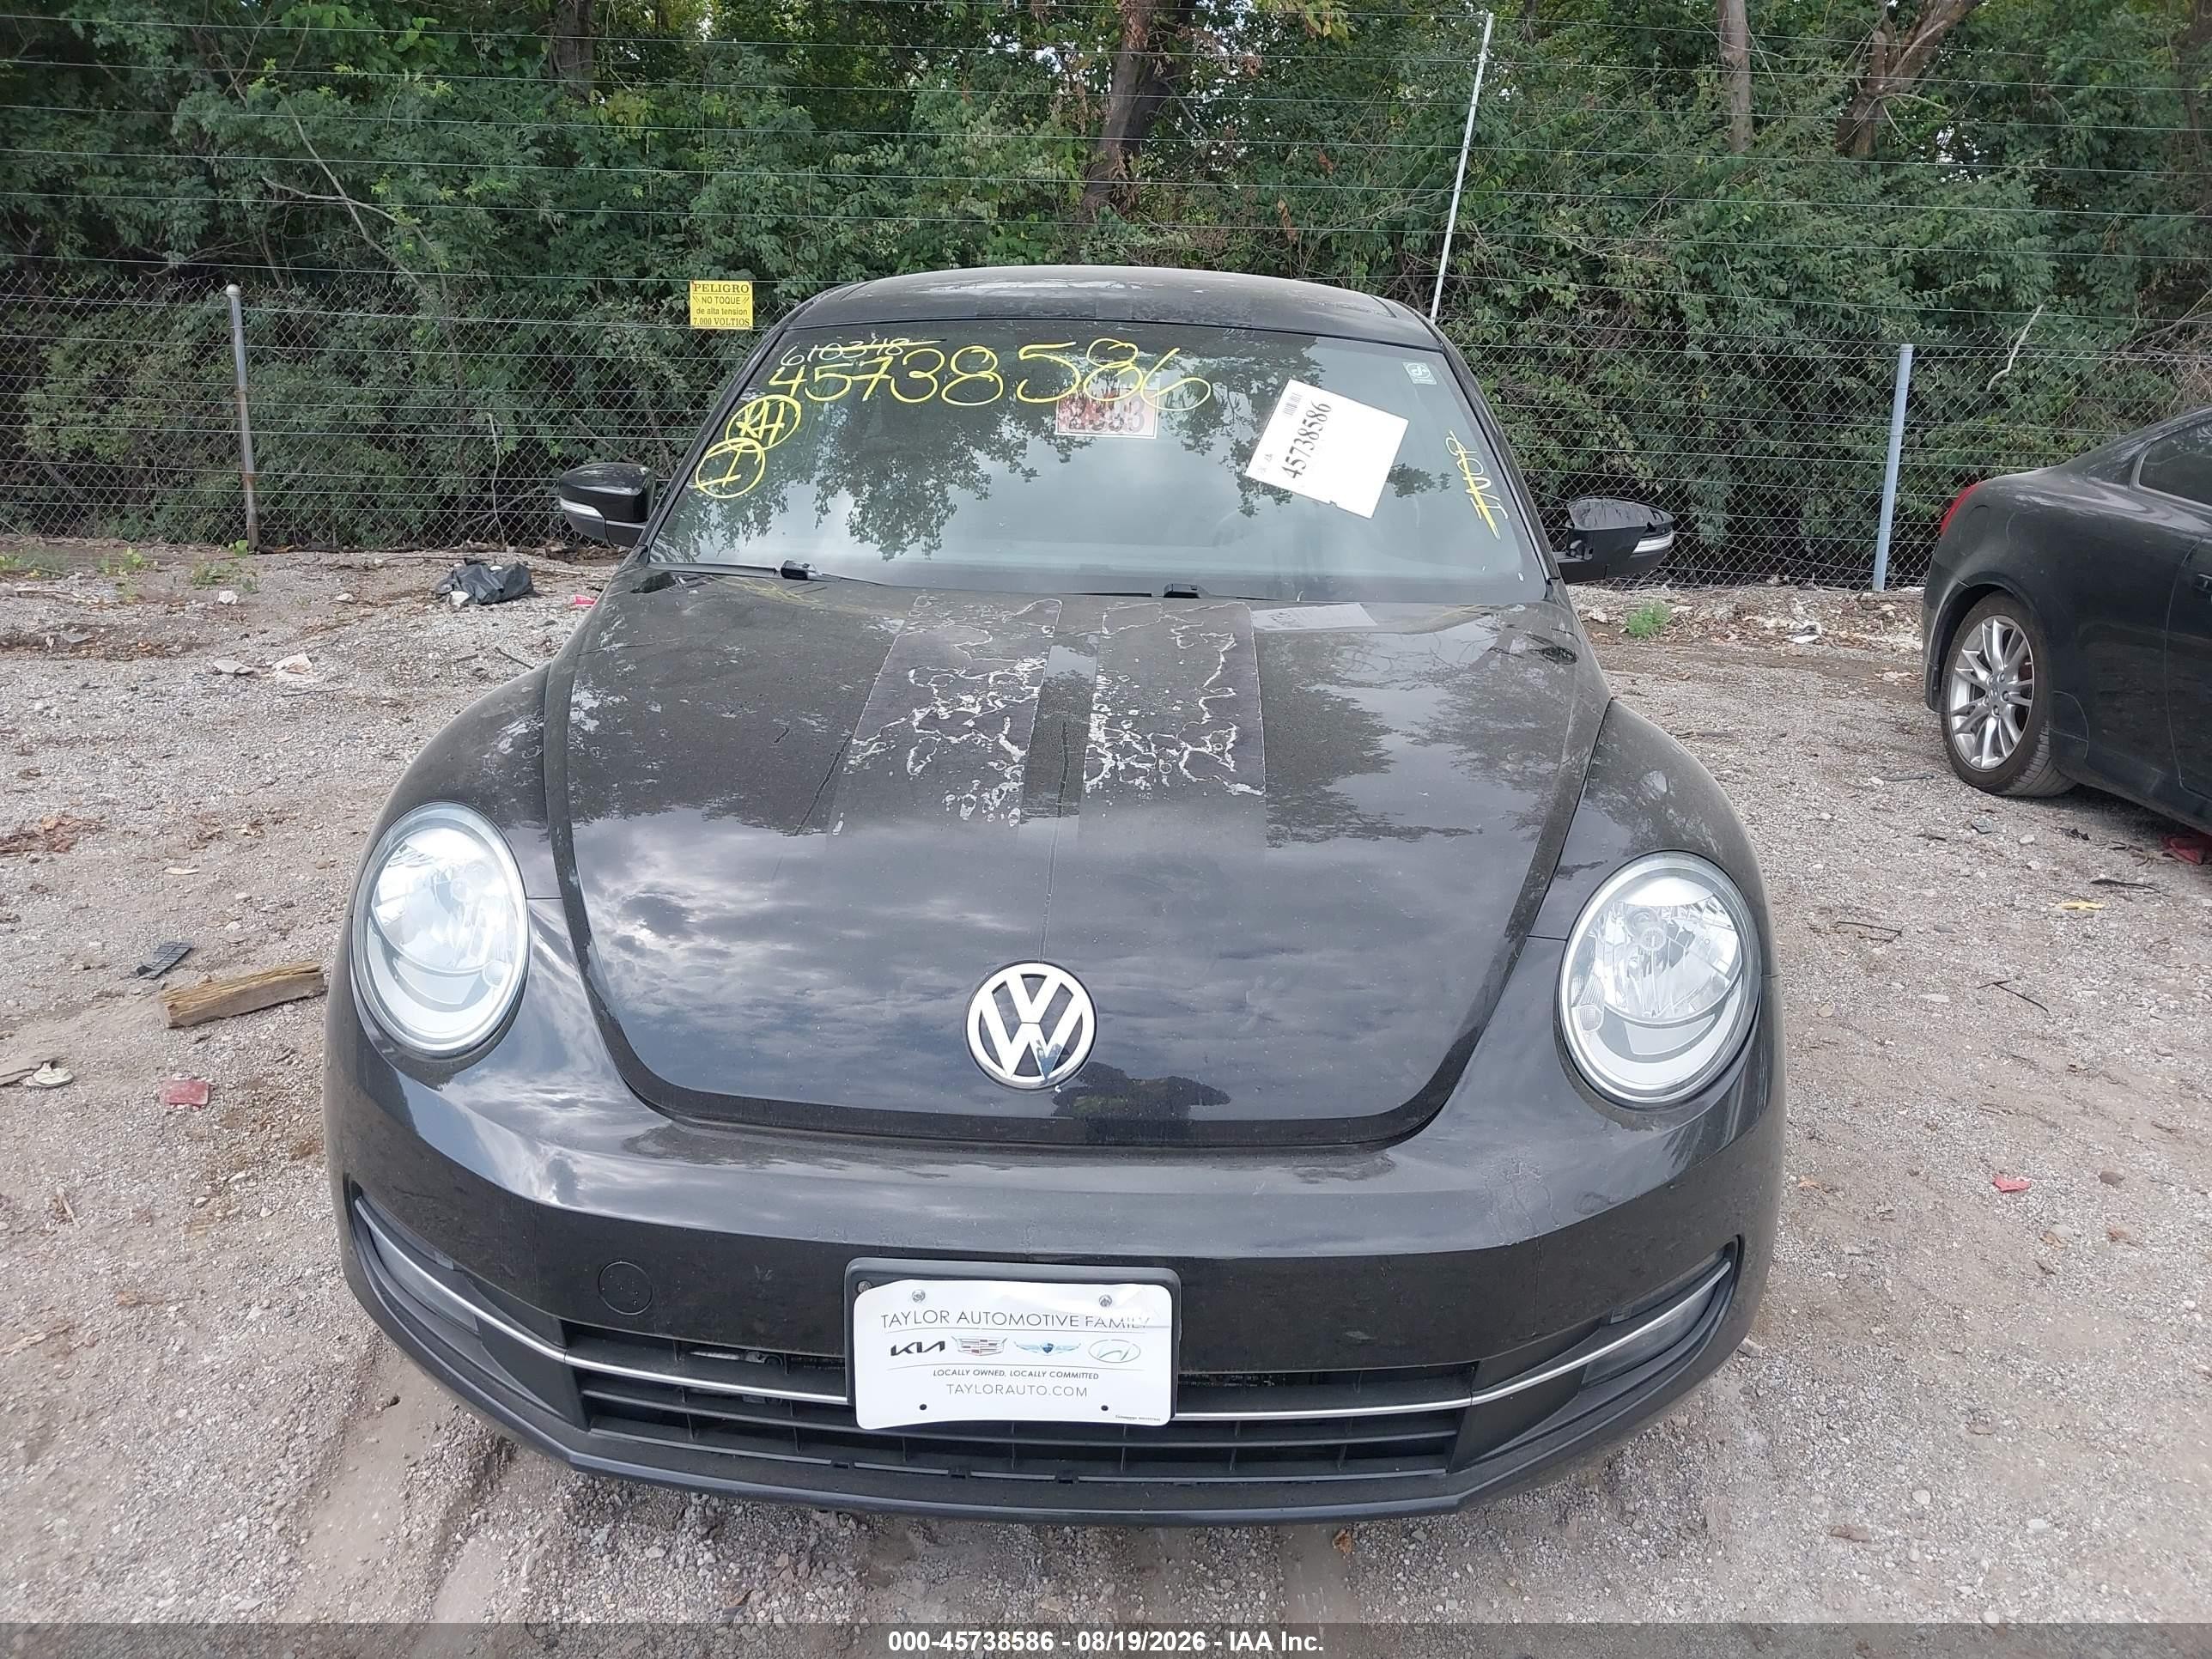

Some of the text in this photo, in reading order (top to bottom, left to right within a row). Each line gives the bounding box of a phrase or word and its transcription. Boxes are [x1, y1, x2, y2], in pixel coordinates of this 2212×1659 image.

[693, 283, 750, 293] PELIGRO
[714, 296, 741, 305] TOQUE
[714, 318, 750, 326] VOLTIOS
[768, 337, 1212, 411] 45738586
[1281, 399, 1333, 479] 45738586
[970, 966, 1091, 1085] VW
[880, 1310, 1151, 1329] TAYLOR AUTOMOTIVE FAMILY
[933, 1369, 1099, 1380] LOCALLY OWNED, LOCALLY COMMITTED
[945, 1383, 1088, 1398] TAYLORAUTO.COM
